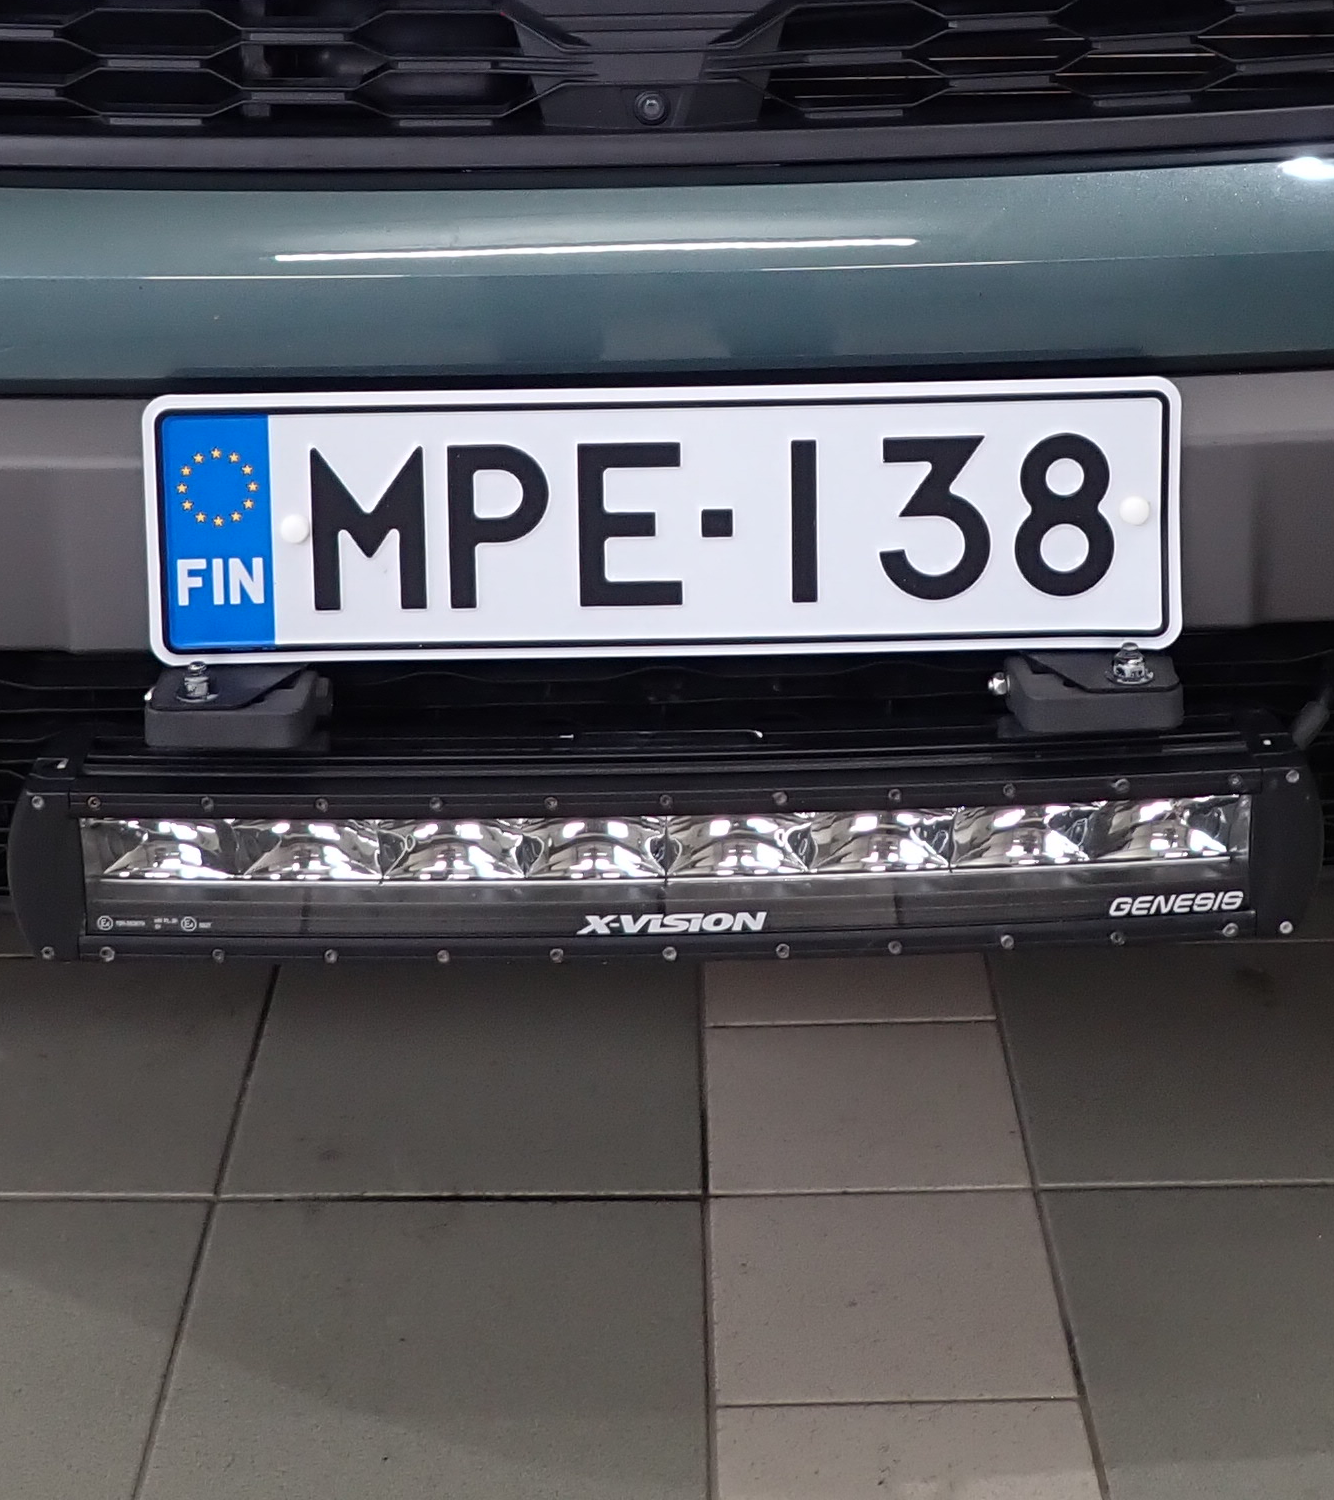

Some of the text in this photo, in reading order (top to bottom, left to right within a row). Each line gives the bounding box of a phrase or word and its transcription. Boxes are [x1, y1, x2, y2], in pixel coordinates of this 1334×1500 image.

[175, 555, 267, 607] FIN
[1108, 890, 1244, 917] GENESIS
[576, 911, 767, 935] X-VISION
